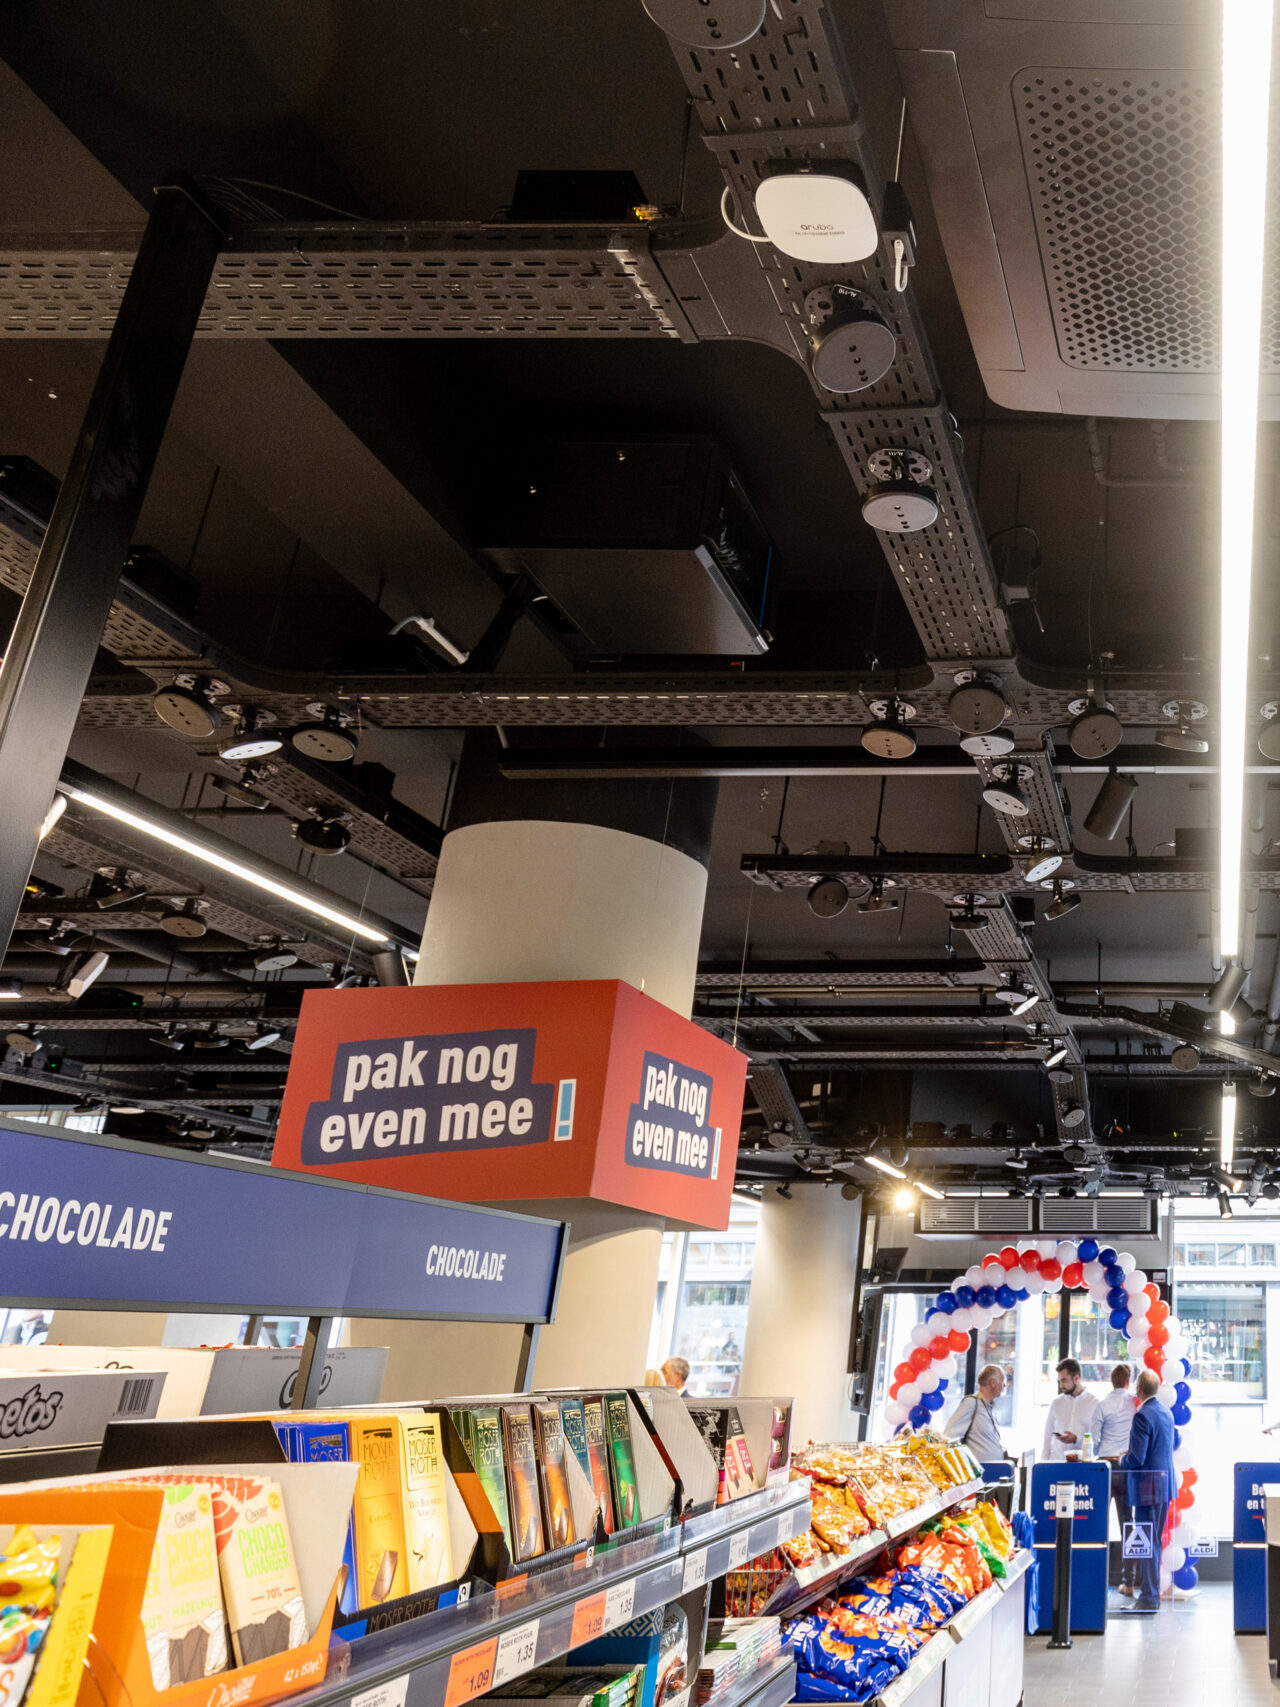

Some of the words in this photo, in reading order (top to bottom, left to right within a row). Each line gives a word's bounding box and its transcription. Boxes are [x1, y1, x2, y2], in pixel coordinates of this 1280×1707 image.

[343, 1040, 429, 1103] pak
[437, 1042, 519, 1091] nog
[645, 1063, 675, 1110] pak
[679, 1076, 708, 1128] nog
[320, 1099, 427, 1153] even
[439, 1098, 534, 1142] mee
[632, 1119, 672, 1161] even
[675, 1134, 709, 1169] mee
[0, 1191, 173, 1252] CHOCOLADE
[426, 1243, 507, 1283] CHOCOLADE
[0, 1384, 63, 1439] etos
[363, 1441, 394, 1461] MOSER
[408, 1438, 436, 1456] MOSER
[364, 1461, 394, 1480] ROTH
[410, 1457, 438, 1475] ROTH
[1049, 1484, 1089, 1496] Bnkt
[1043, 1500, 1056, 1511] en
[1074, 1497, 1094, 1510] snel
[1247, 1500, 1259, 1510] en
[238, 1522, 286, 1551] CHOCO
[1193, 1546, 1214, 1554] ALDI
[241, 1550, 290, 1577] CHANGER
[266, 1586, 282, 1601] 70%
[369, 1606, 403, 1634] MOSER
[405, 1598, 436, 1621] ROTH
[620, 1597, 633, 1615] 1.35
[587, 1616, 603, 1635] 1.09
[517, 1642, 534, 1665] 1.35
[284, 1669, 295, 1683] 42
[470, 1668, 489, 1693] 1.09
